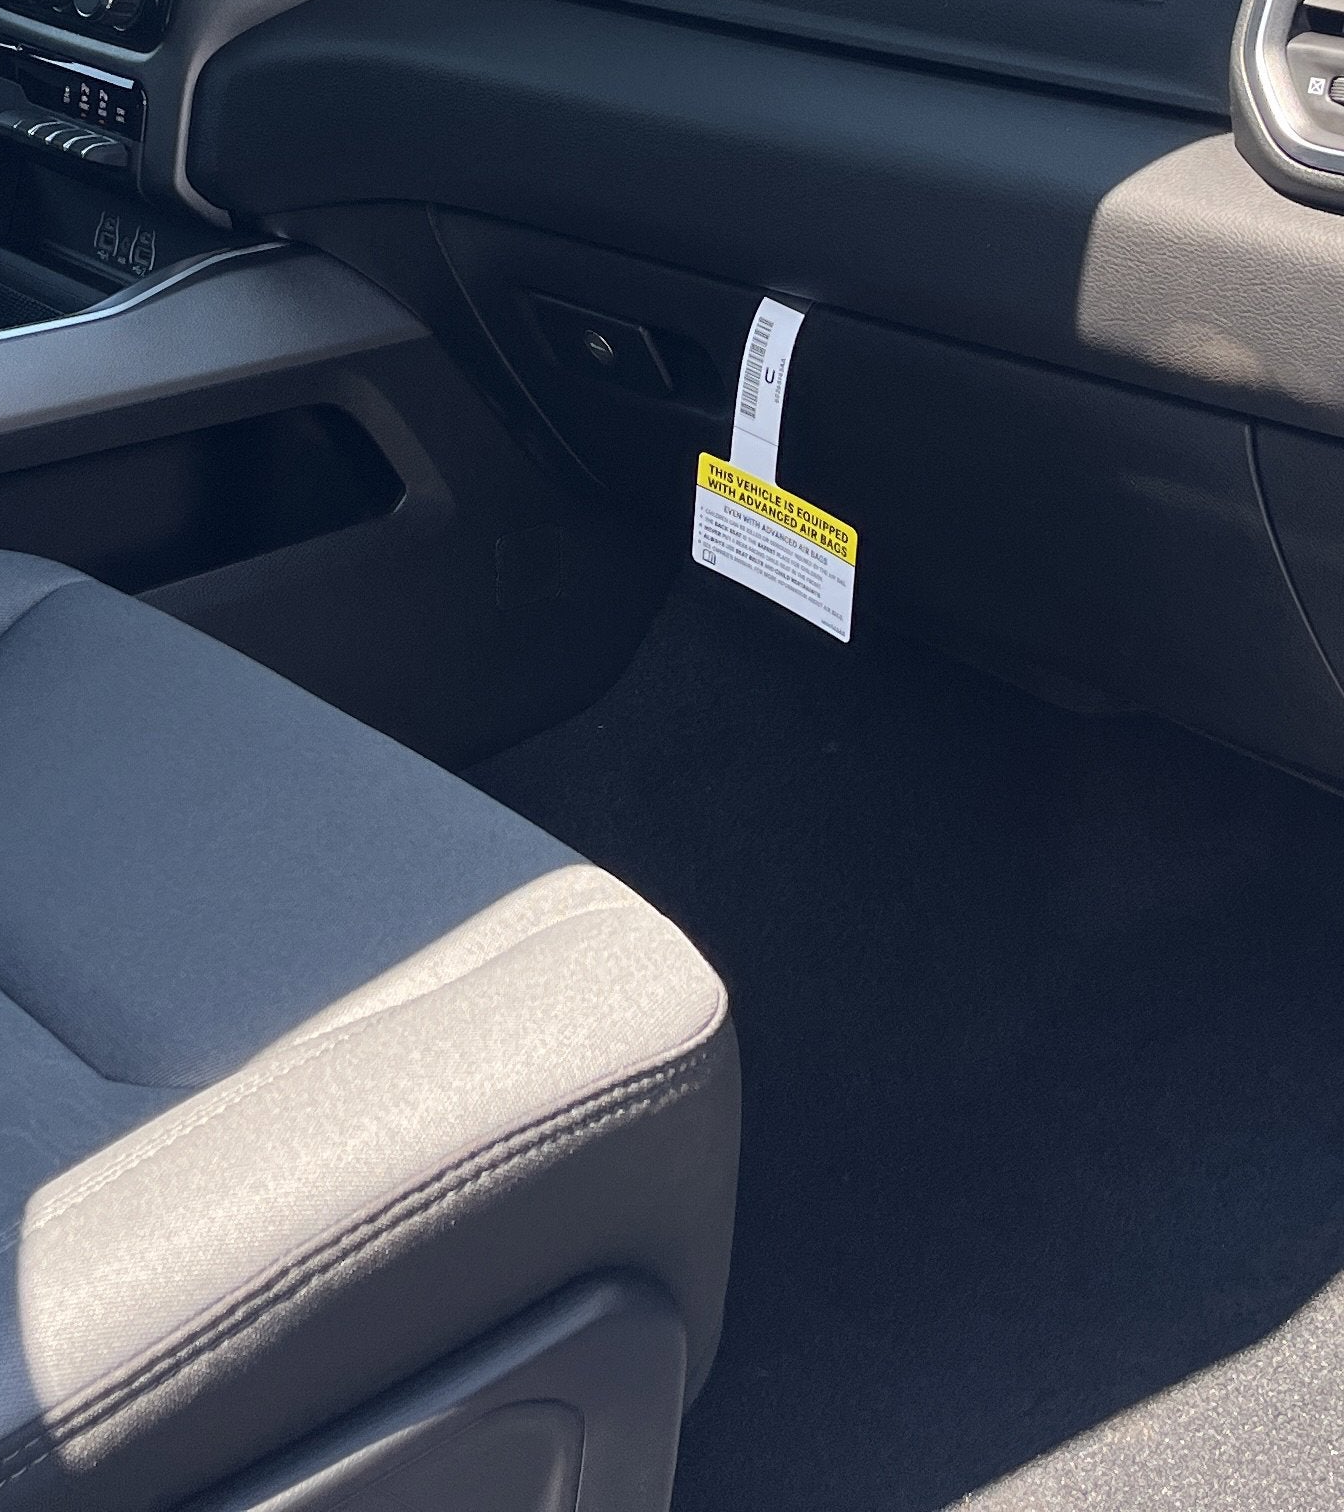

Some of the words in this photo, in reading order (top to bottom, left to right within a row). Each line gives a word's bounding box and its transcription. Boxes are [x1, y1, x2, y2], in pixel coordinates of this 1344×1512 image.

[708, 476, 736, 499] WITH
[739, 491, 797, 528] ADVANCED
[800, 523, 818, 540] AIR
[820, 534, 848, 558] BAGS
[709, 463, 733, 484] THIS
[736, 476, 781, 507] VEHICLE
[784, 500, 794, 514] IS
[797, 506, 849, 544] EQUIPPED
[724, 505, 742, 522] EVEN
[743, 514, 761, 530] WITH
[761, 525, 798, 550] ADVANCED
[798, 542, 810, 555] AIR
[810, 548, 828, 566] BAGS
